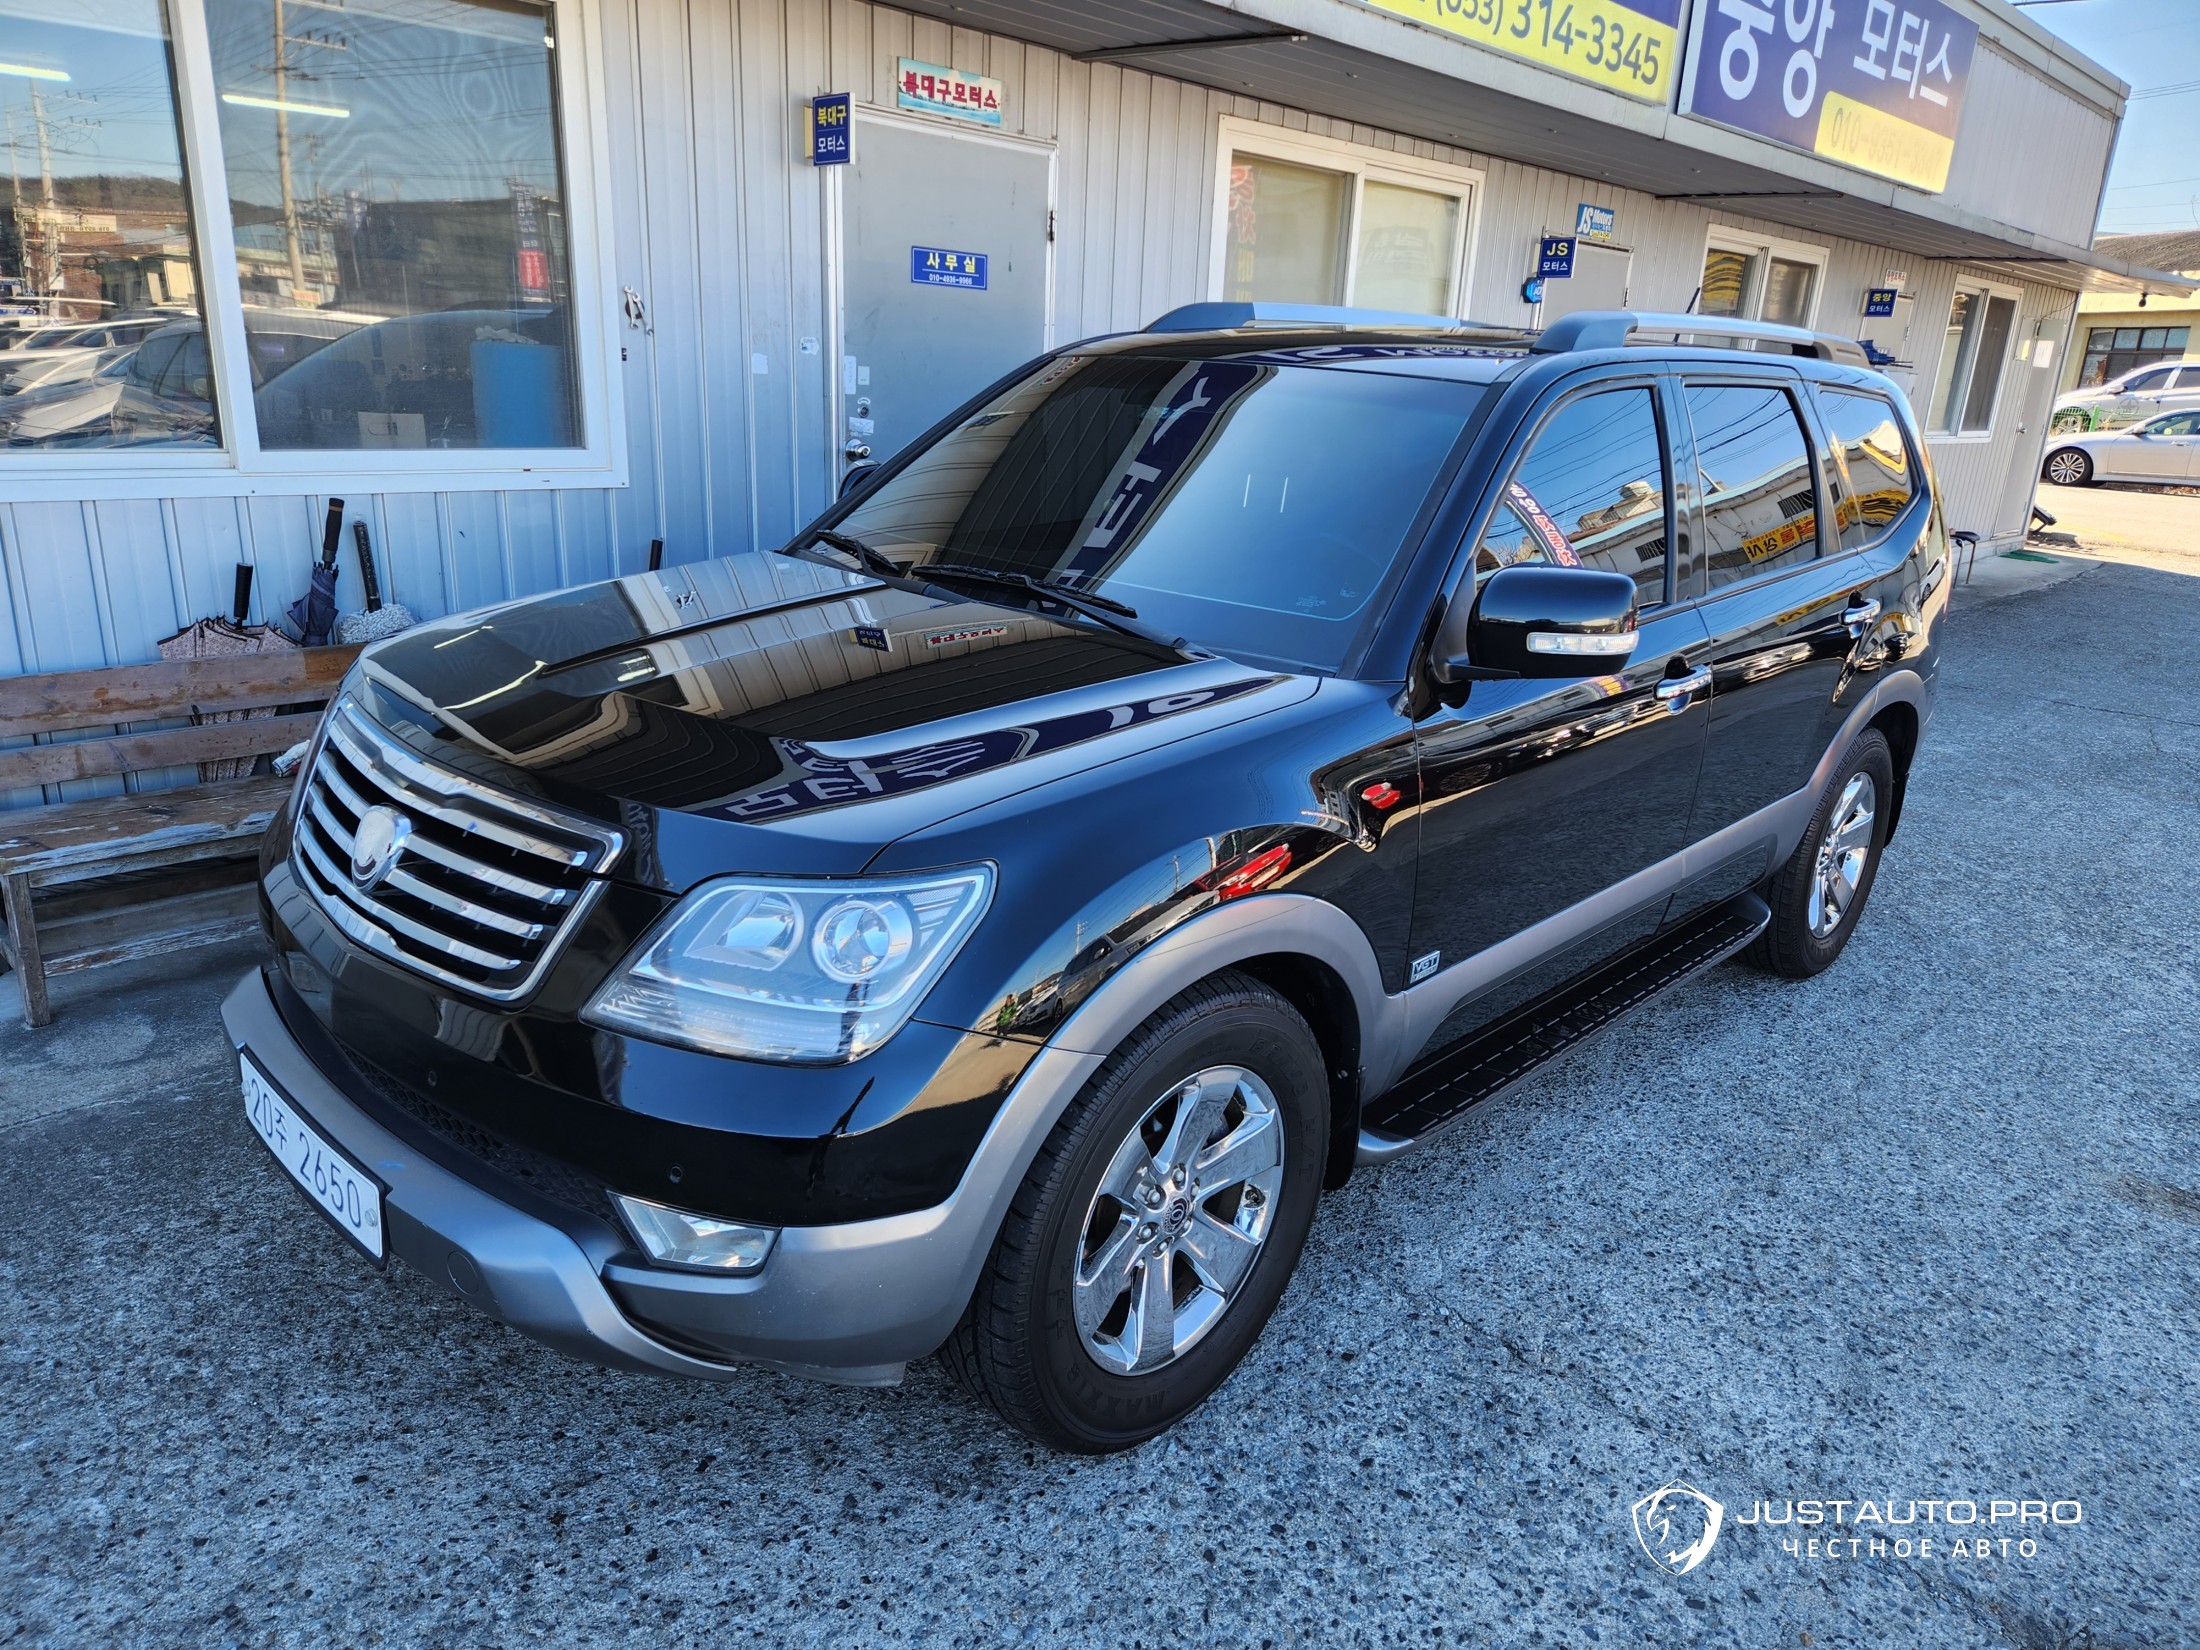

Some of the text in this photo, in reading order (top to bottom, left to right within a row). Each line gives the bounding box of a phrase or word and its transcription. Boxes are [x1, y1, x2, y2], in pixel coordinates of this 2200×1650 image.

[1509, 0, 1661, 86] 314-3345
[1853, 0, 1952, 107] 모터스
[902, 70, 998, 110] 북대구모터스
[817, 104, 847, 126] 북대구
[817, 135, 846, 153] 모터스
[1577, 206, 1593, 233] JS
[1546, 243, 1568, 256] JS
[1542, 261, 1568, 271] 모터스
[1869, 304, 1890, 312] 모터스
[251, 1077, 361, 1229] 20주 2650
